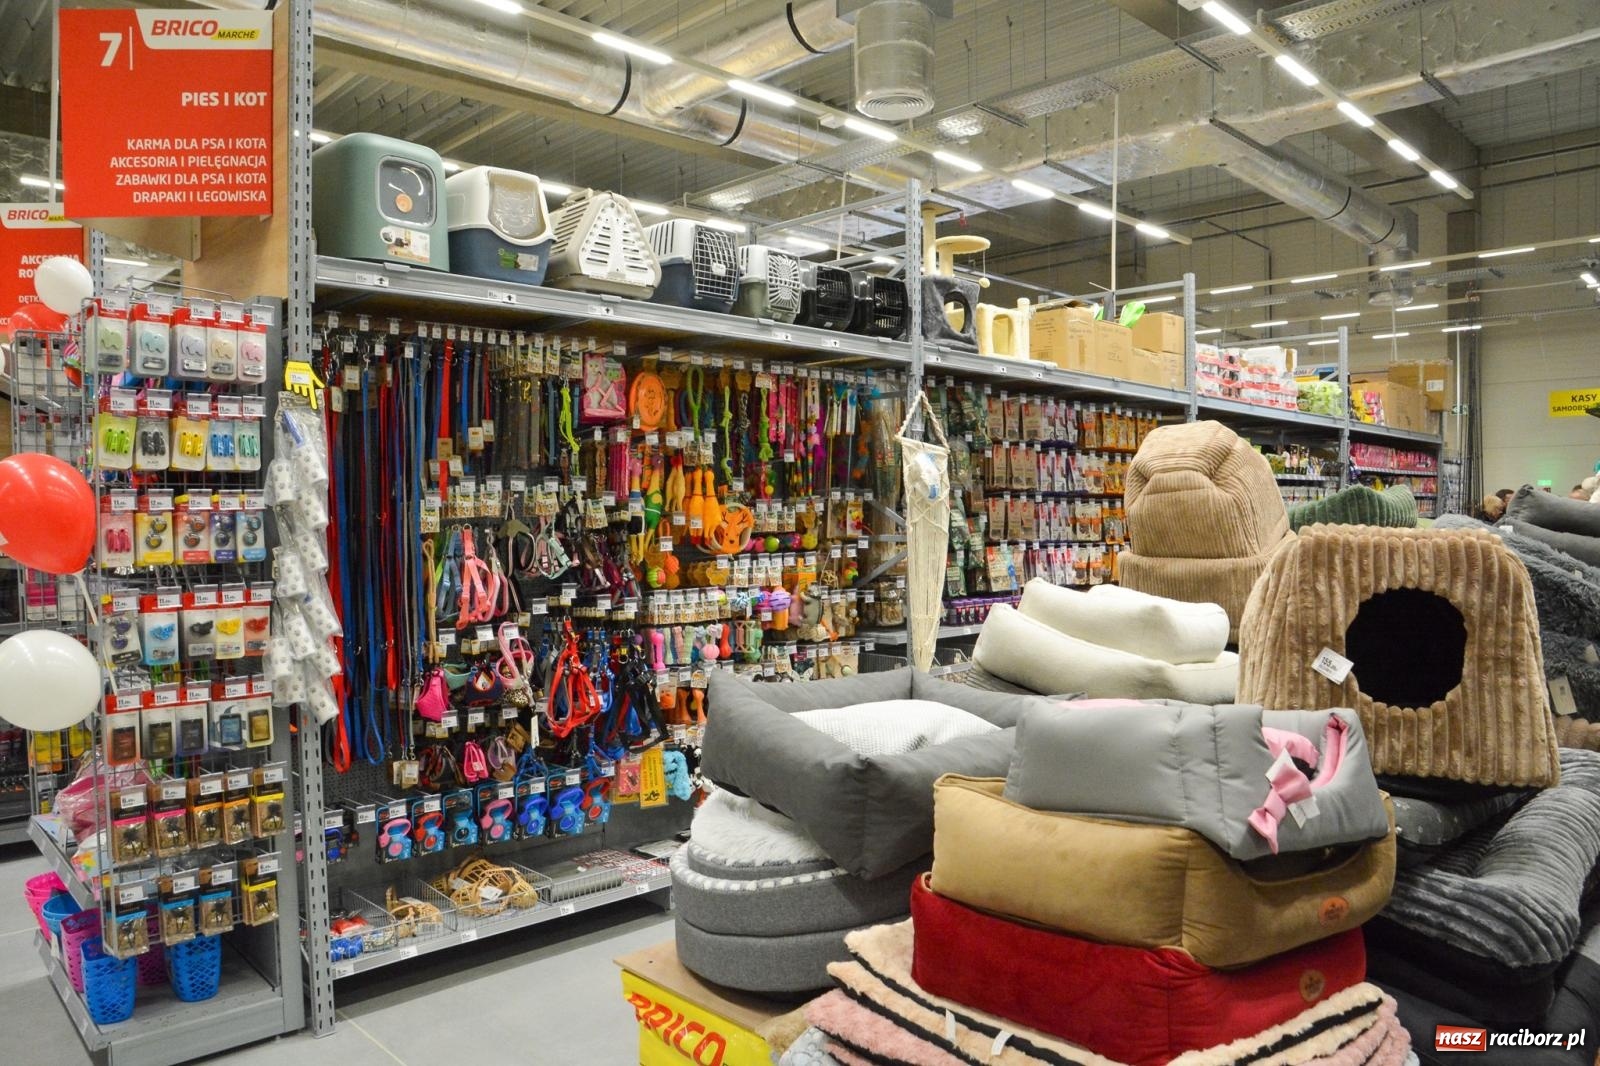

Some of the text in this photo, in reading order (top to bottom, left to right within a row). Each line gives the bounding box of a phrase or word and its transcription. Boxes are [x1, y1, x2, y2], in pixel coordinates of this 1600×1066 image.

[151, 20, 218, 36] BRICO
[99, 32, 123, 67] 7
[181, 91, 267, 107] PIES I KOT
[127, 138, 171, 150] KARMA
[174, 138, 198, 150] DLA
[201, 138, 225, 149] PSA
[236, 138, 267, 149] KOTA
[110, 156, 177, 168] AKCESORIA
[188, 155, 267, 169] PIELĘGNACJA
[115, 173, 171, 186] ZABAWKI
[174, 173, 198, 185] DLA
[201, 173, 225, 184] PSA
[236, 173, 267, 184] KOTA
[133, 191, 186, 203] DRAPAKI
[197, 190, 267, 202] LEGOWISKA
[7, 209, 49, 220] BRICO
[1571, 394, 1597, 403] KASY
